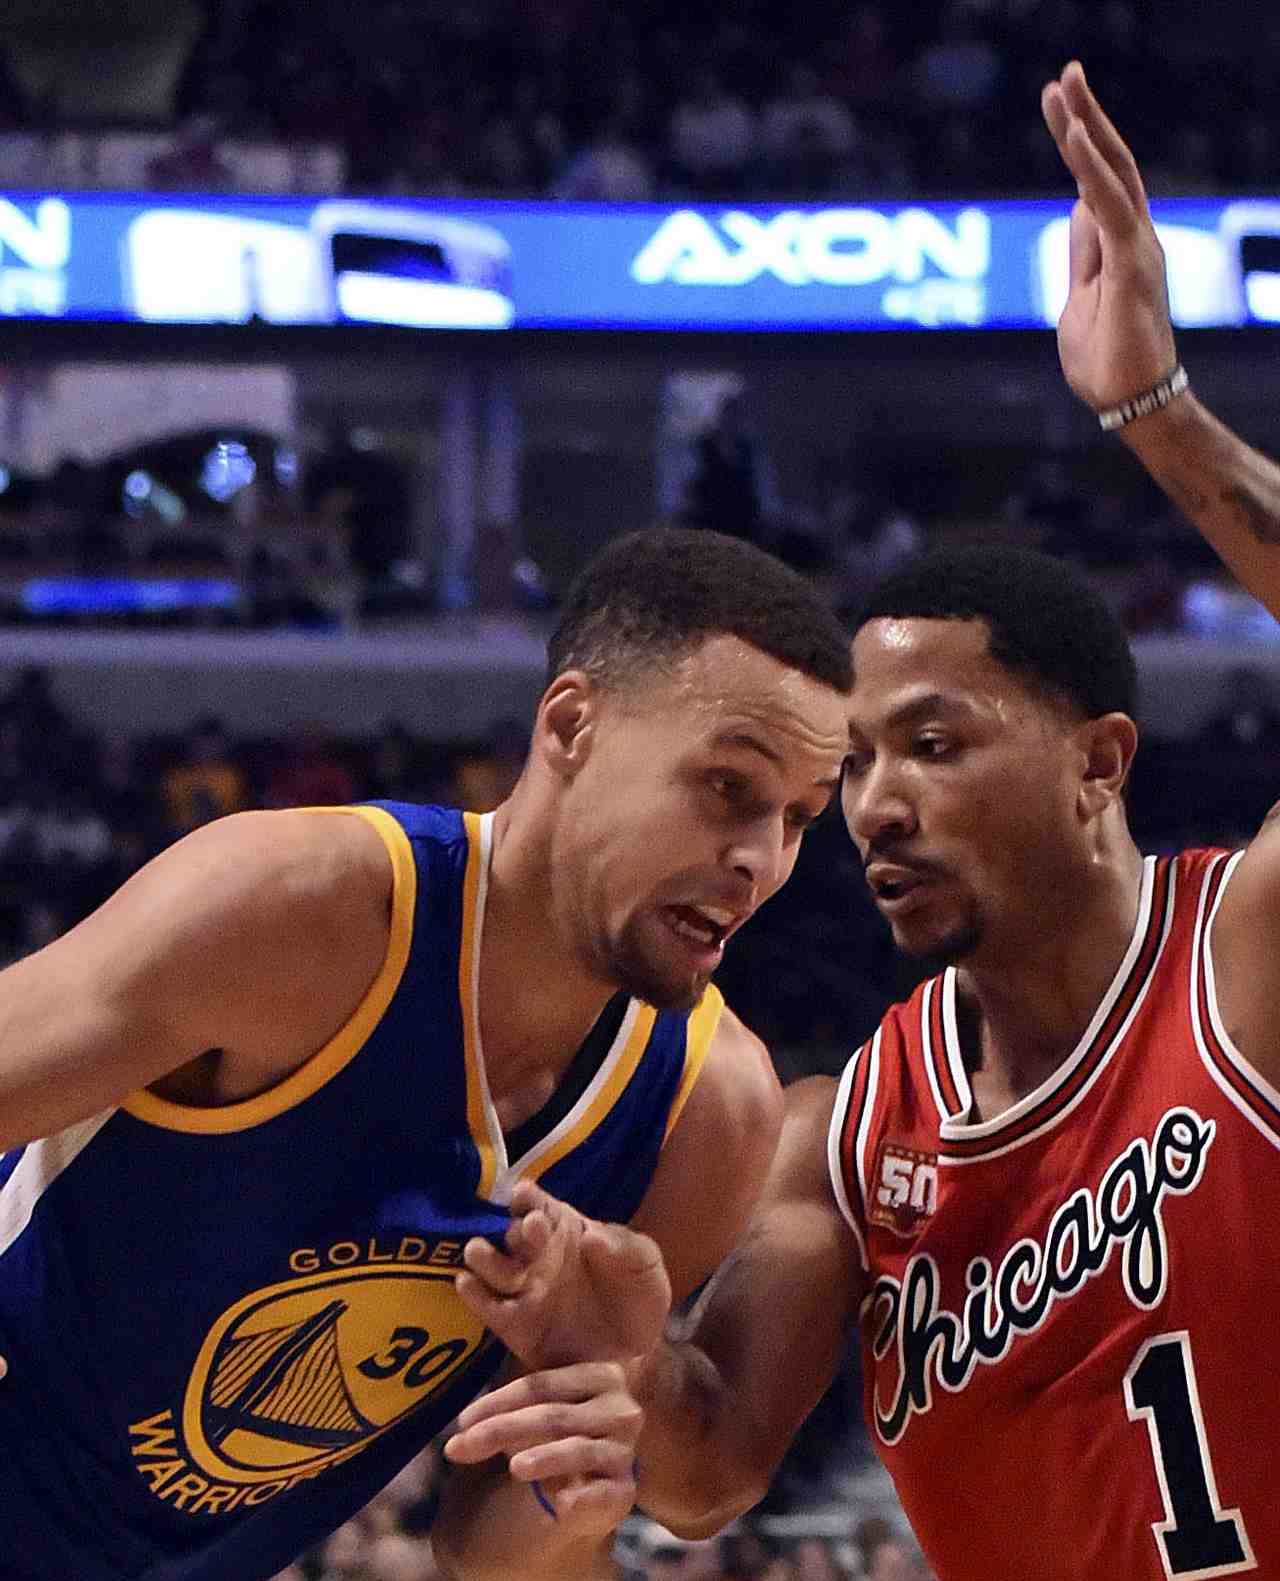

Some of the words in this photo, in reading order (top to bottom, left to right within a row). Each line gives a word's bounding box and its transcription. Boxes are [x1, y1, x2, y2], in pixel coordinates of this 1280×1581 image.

[631, 208, 992, 287] AXON
[860, 1107, 1216, 1446] Chicago
[356, 1326, 470, 1388] 30
